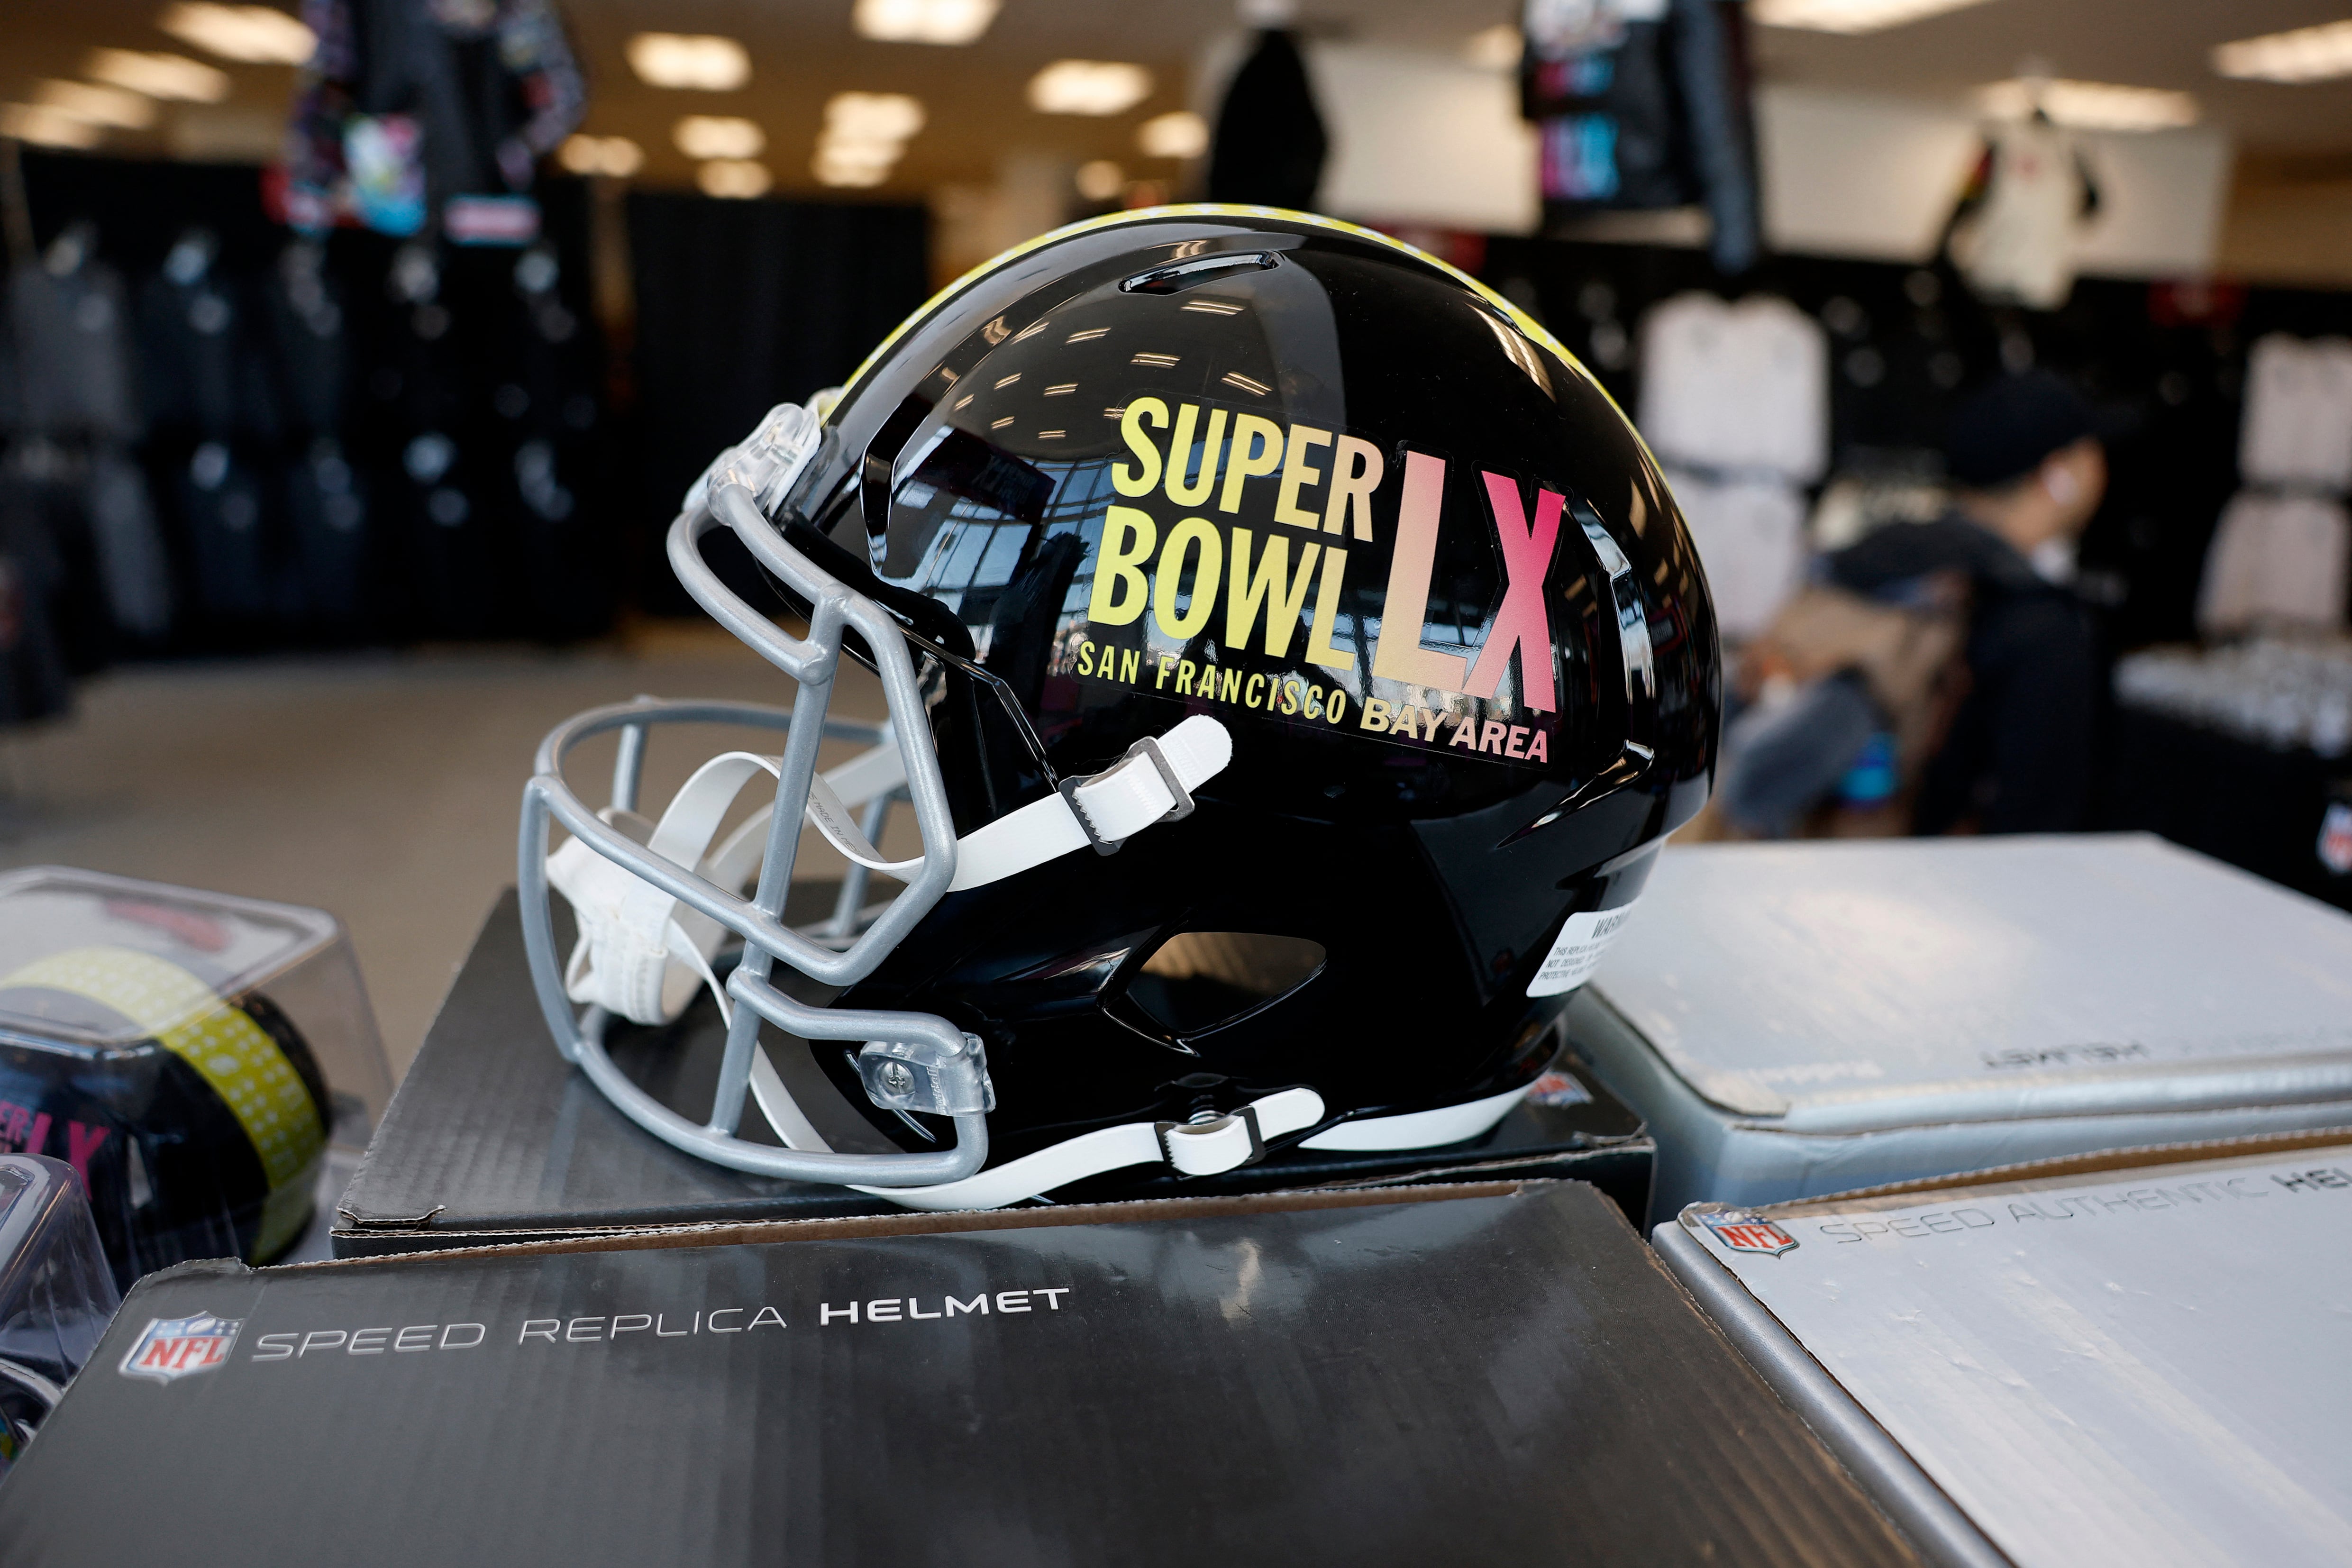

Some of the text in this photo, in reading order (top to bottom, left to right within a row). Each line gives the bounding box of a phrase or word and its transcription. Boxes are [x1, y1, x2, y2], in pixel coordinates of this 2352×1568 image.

[1111, 397, 1384, 542] SUPER
[1087, 506, 1355, 672] BOWL
[1373, 451, 1566, 712] LX
[1077, 642, 1548, 763] SAN FRANCISCO BAY AREA
[813, 802, 843, 836] MADE IN
[1715, 1224, 1793, 1249] NFL
[1820, 1207, 1995, 1243] SPEED
[2008, 1178, 2269, 1224] AUTHENTIC
[140, 1337, 225, 1371] NFL
[252, 1288, 1069, 1362] SPEED REPLICA HELMET
